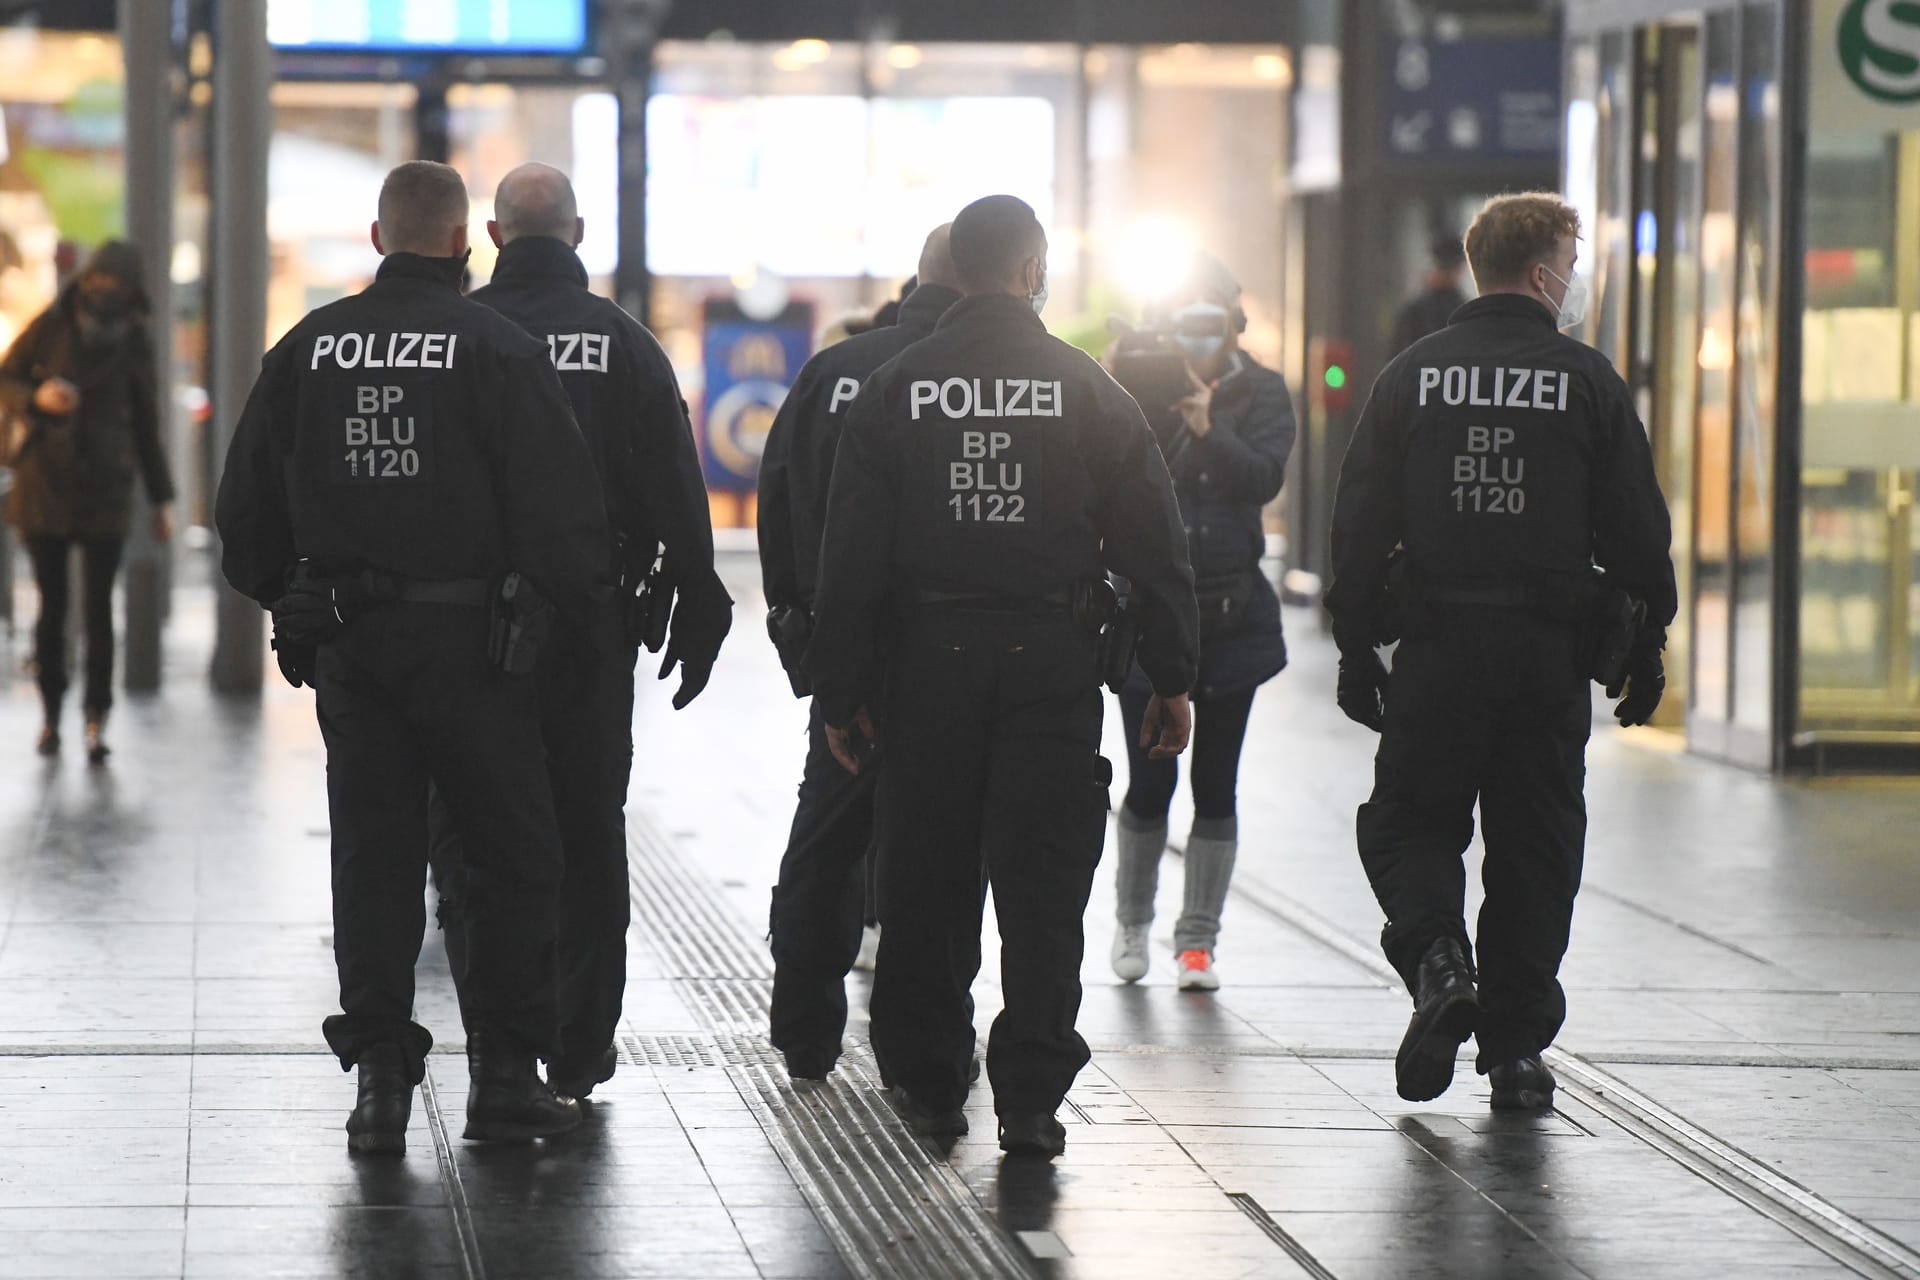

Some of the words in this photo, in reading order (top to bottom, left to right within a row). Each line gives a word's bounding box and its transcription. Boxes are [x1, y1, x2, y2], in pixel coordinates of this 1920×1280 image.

[311, 332, 457, 370] POLIZEI
[547, 332, 610, 373] IZEI
[357, 386, 404, 414] BP
[910, 377, 1063, 420] POLIZEI
[1419, 366, 1569, 412] POLIZEI
[346, 417, 415, 446] BLU
[963, 431, 1012, 459] BP
[1467, 426, 1515, 454] BP
[344, 449, 419, 477] 1120
[950, 462, 1022, 491] BLU
[1453, 455, 1524, 485] BLU
[949, 494, 1025, 523] 1122
[1451, 485, 1525, 514] 1120
